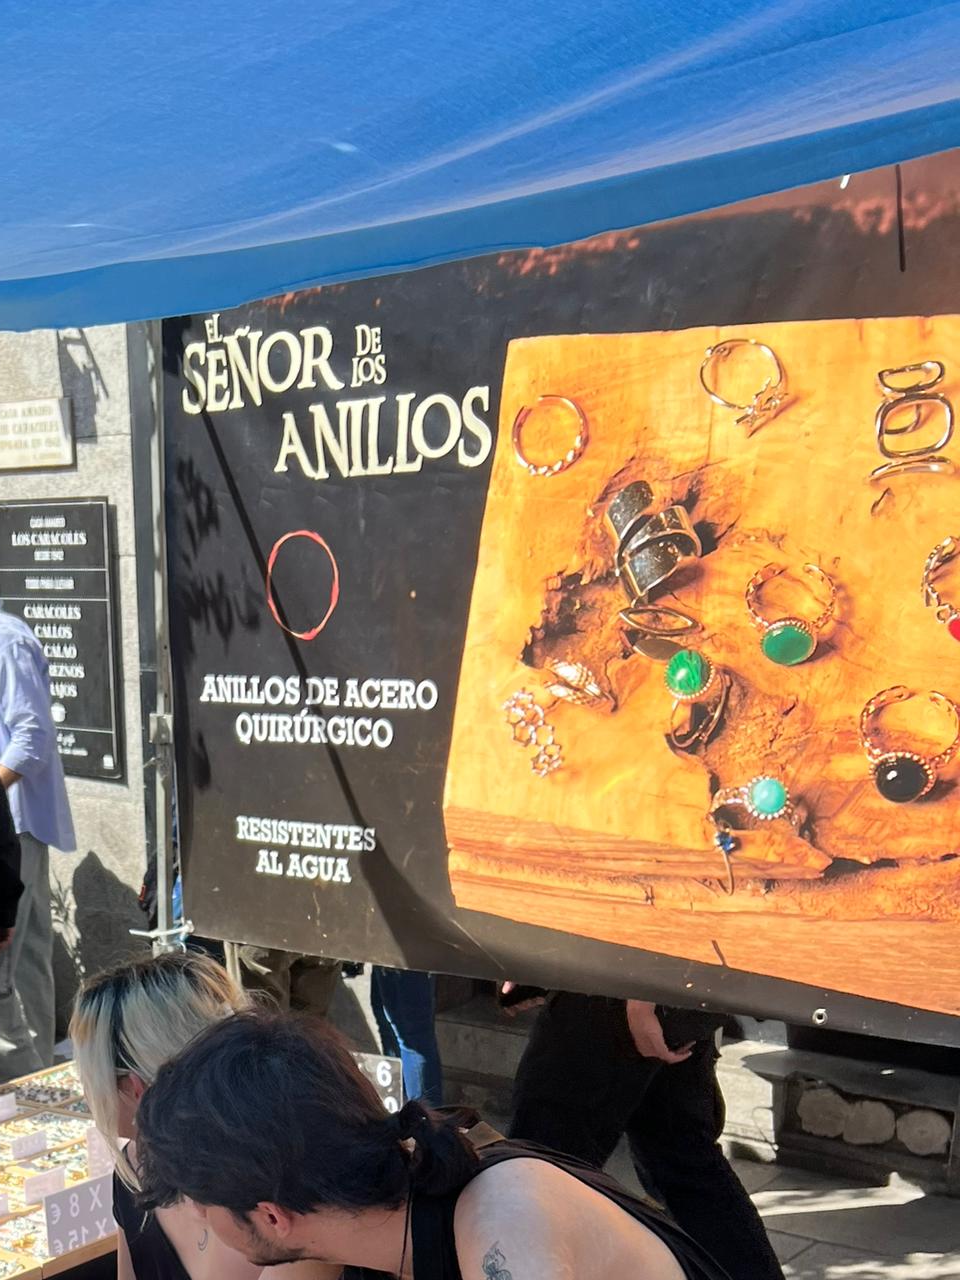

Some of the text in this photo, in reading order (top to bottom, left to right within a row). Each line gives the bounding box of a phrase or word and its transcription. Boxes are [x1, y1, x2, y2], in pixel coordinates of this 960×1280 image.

[204, 314, 222, 344] EL
[354, 324, 382, 356] DE
[181, 326, 345, 415] SEÑOR
[350, 354, 387, 388] LOS
[273, 385, 492, 480] ANILLOS
[11, 529, 87, 546] LOS CARACOLES
[23, 602, 82, 620] CARACOLES
[34, 623, 73, 640] CALLOS
[43, 643, 78, 660] CALAO
[200, 674, 439, 710] ANILLOS DE ACERO
[235, 707, 394, 748] QUIRÚRGICO
[235, 815, 376, 851] RESISTENTES
[256, 849, 352, 884] AL AGUA
